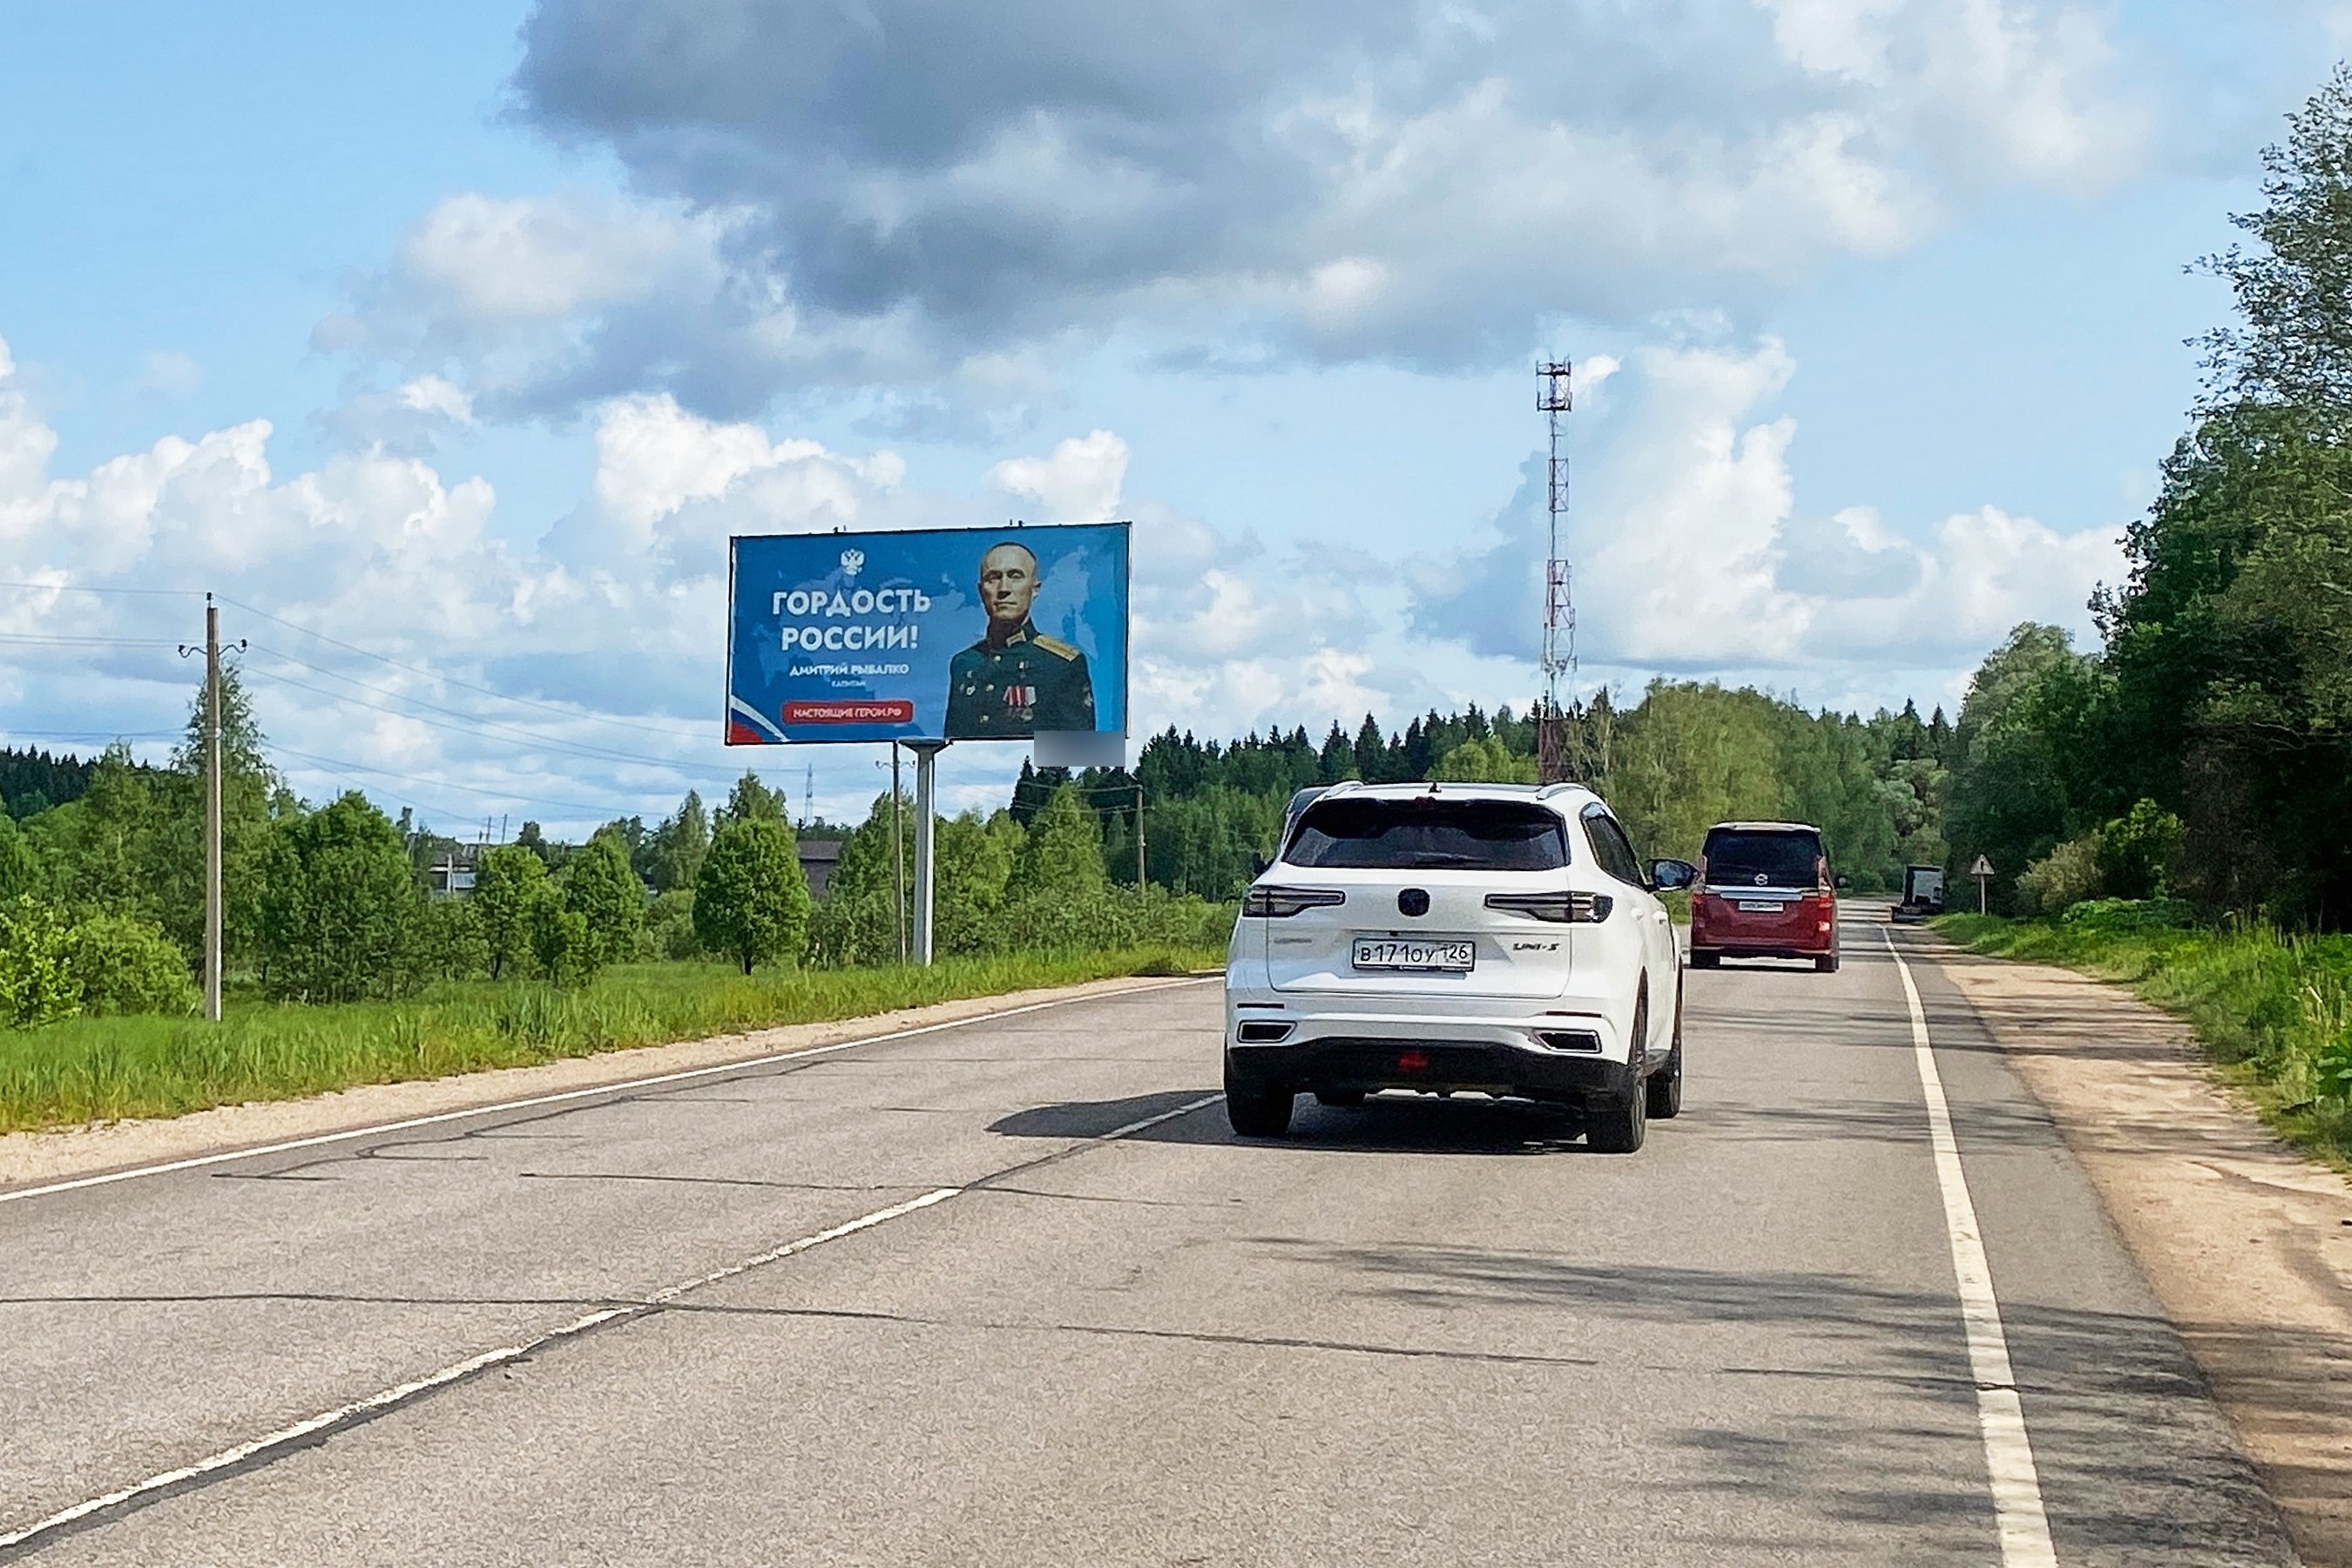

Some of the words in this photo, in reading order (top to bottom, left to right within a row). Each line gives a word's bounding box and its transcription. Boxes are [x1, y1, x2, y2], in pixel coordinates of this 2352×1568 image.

[773, 589, 931, 618] ГОРДОСТЬ
[781, 625, 918, 651] РОССИИ!
[789, 663, 848, 676] ДМИТРИЙ
[851, 664, 909, 675] РЫБАЛКО
